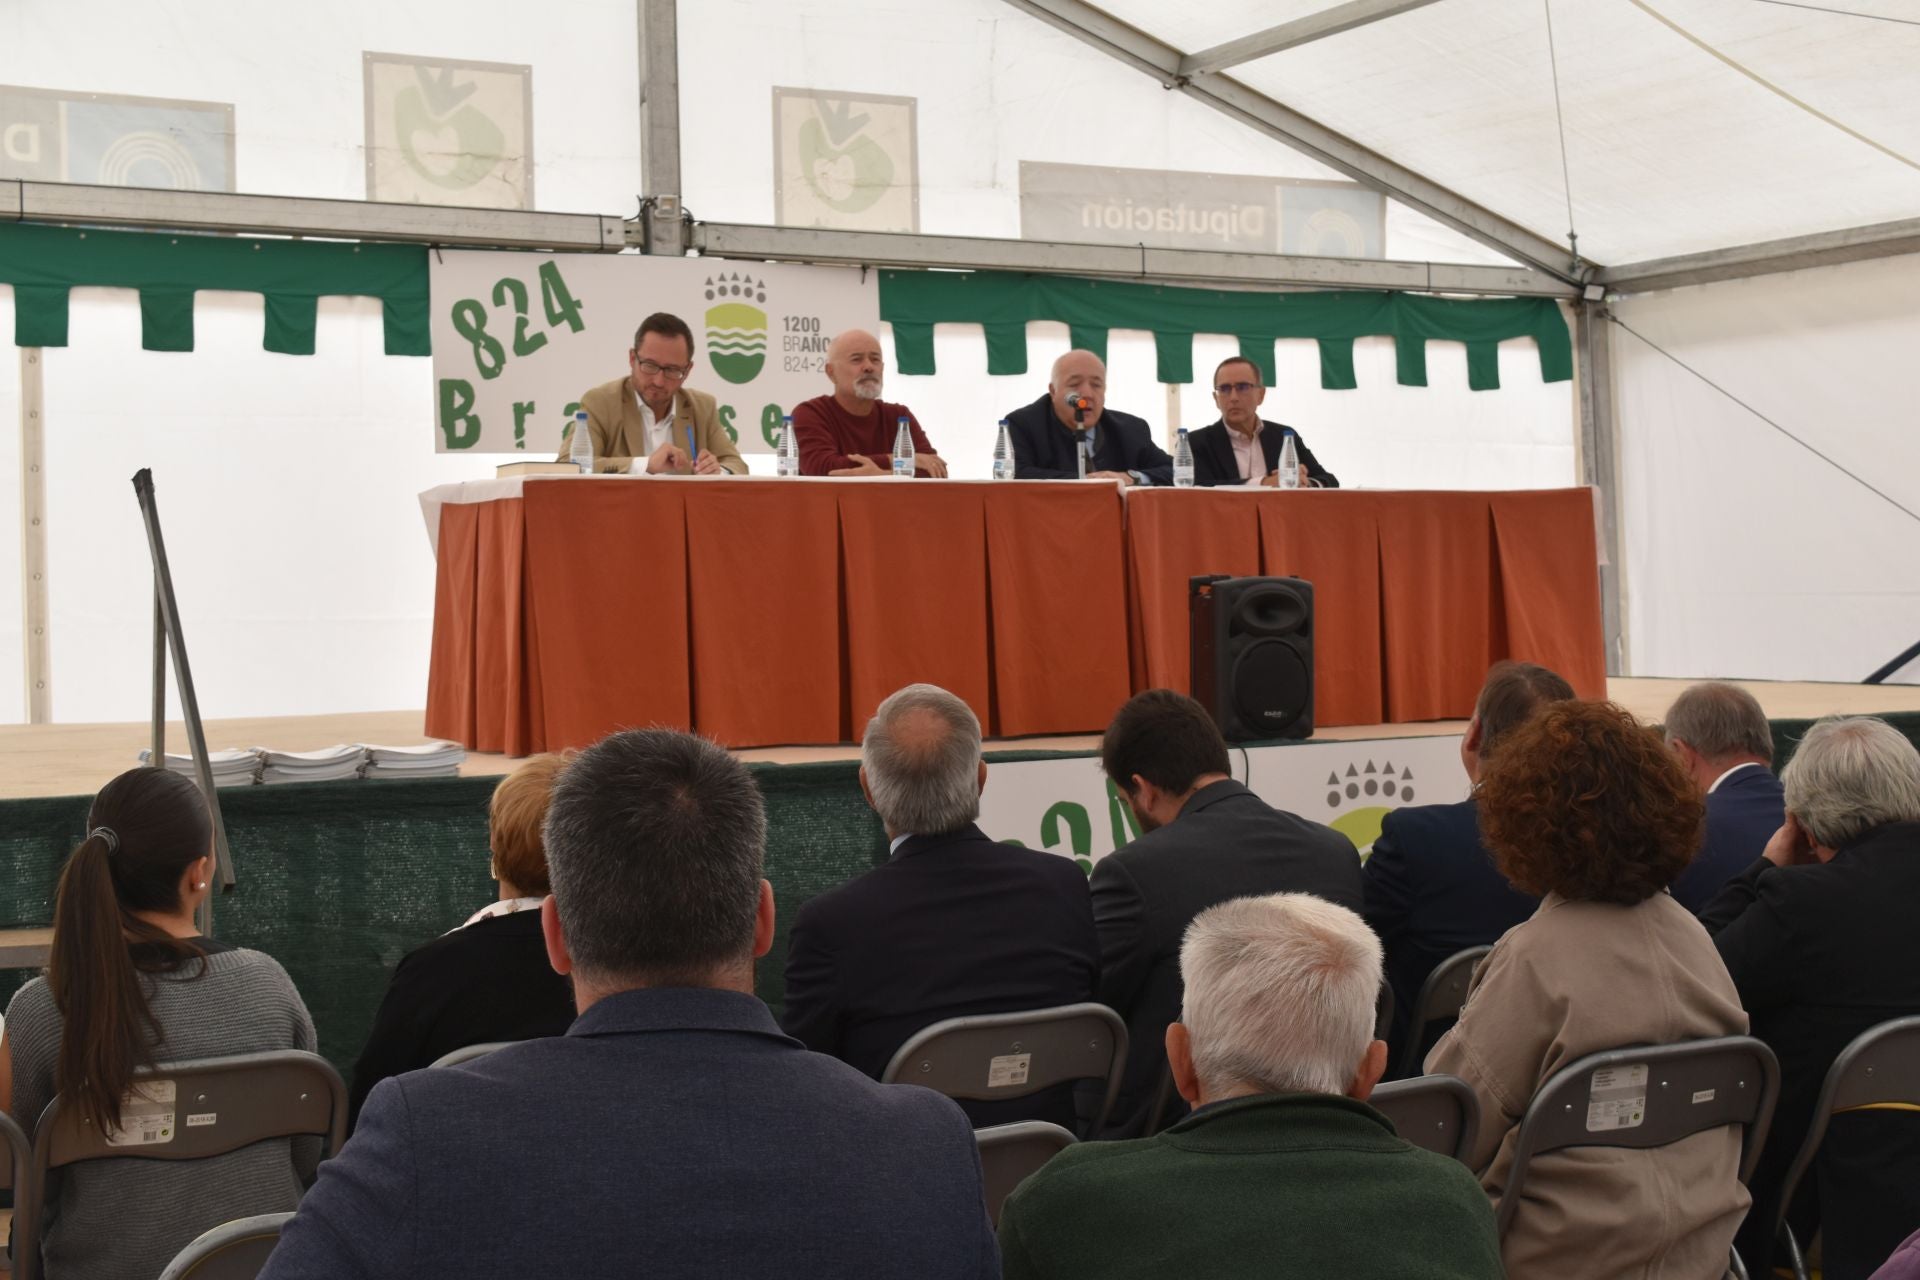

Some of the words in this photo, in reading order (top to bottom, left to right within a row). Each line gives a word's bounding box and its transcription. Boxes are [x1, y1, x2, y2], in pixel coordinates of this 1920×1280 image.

[452, 260, 585, 380] 824
[783, 316, 820, 332] 1200
[783, 333, 831, 353] BRAÑO
[784, 355, 825, 373] 824-2
